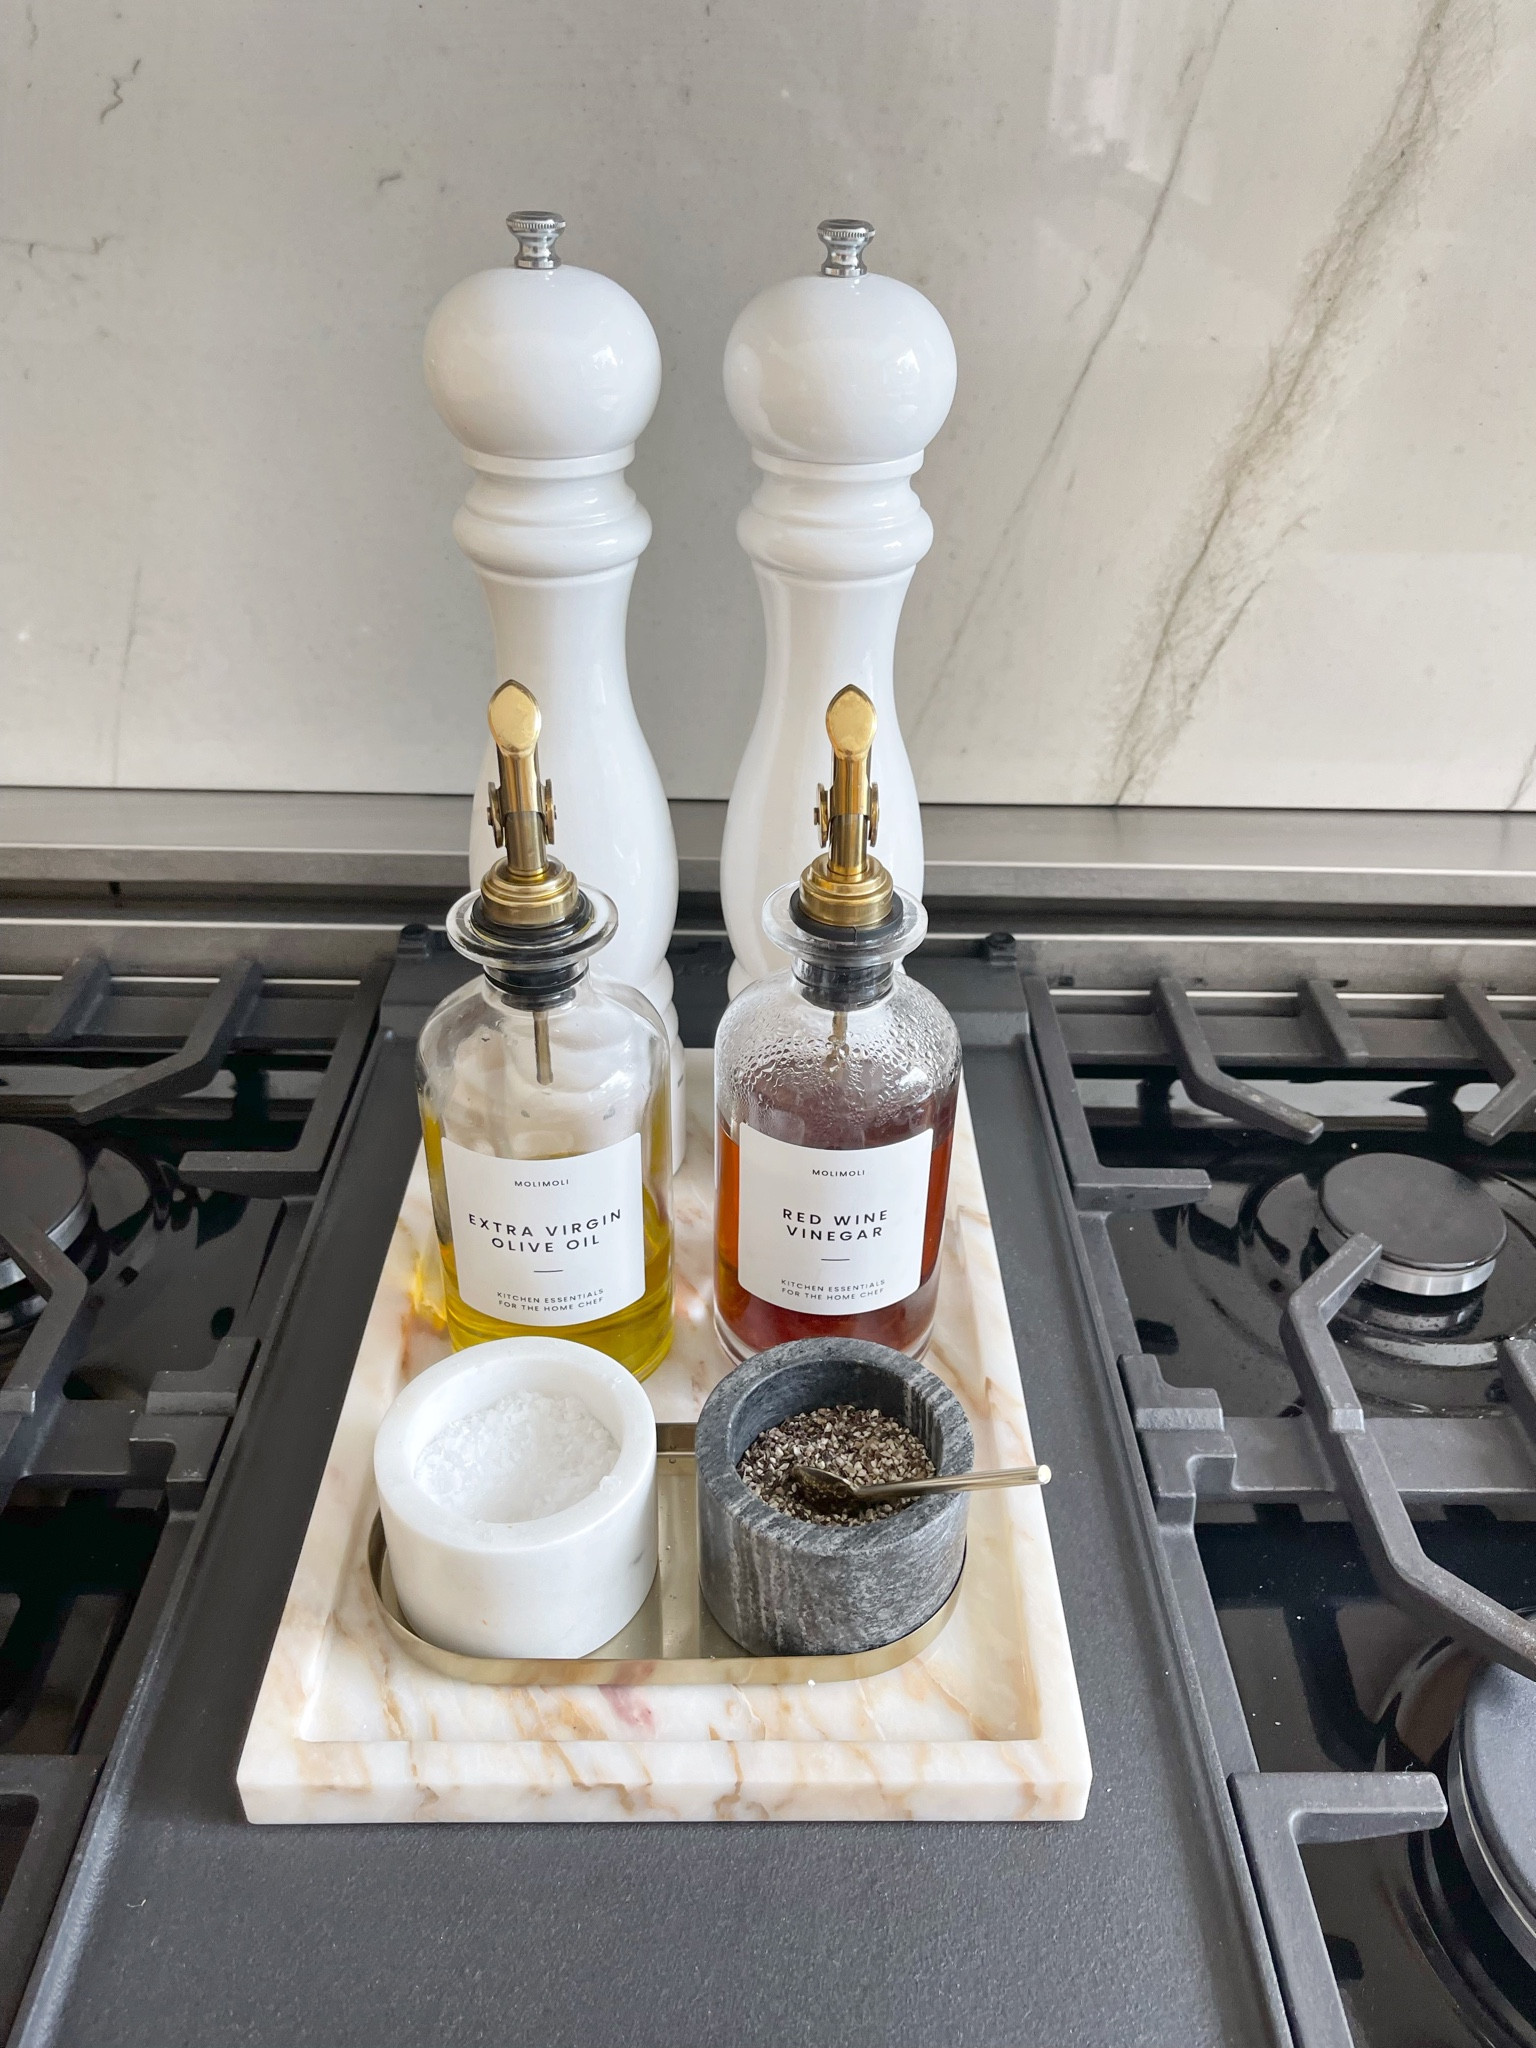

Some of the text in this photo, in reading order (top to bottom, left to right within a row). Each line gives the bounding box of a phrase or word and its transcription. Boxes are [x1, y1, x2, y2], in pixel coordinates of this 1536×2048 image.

[812, 1169, 865, 1177] MOLIMOLI
[514, 1179, 569, 1187] MOLIMOLI
[468, 1209, 621, 1237] EXTRA VIRGIN
[782, 1208, 888, 1226] RED WINE
[786, 1225, 882, 1241] VINEGAR
[491, 1235, 600, 1253] OLIVE OIL
[781, 1279, 886, 1292] KITCHEN ESSENTIALS
[497, 1288, 605, 1304] KITCHEN ESSENTIALS
[781, 1287, 885, 1301] FOR THE HOME CHEF
[498, 1297, 603, 1312] FOR THE HOME CHEF
